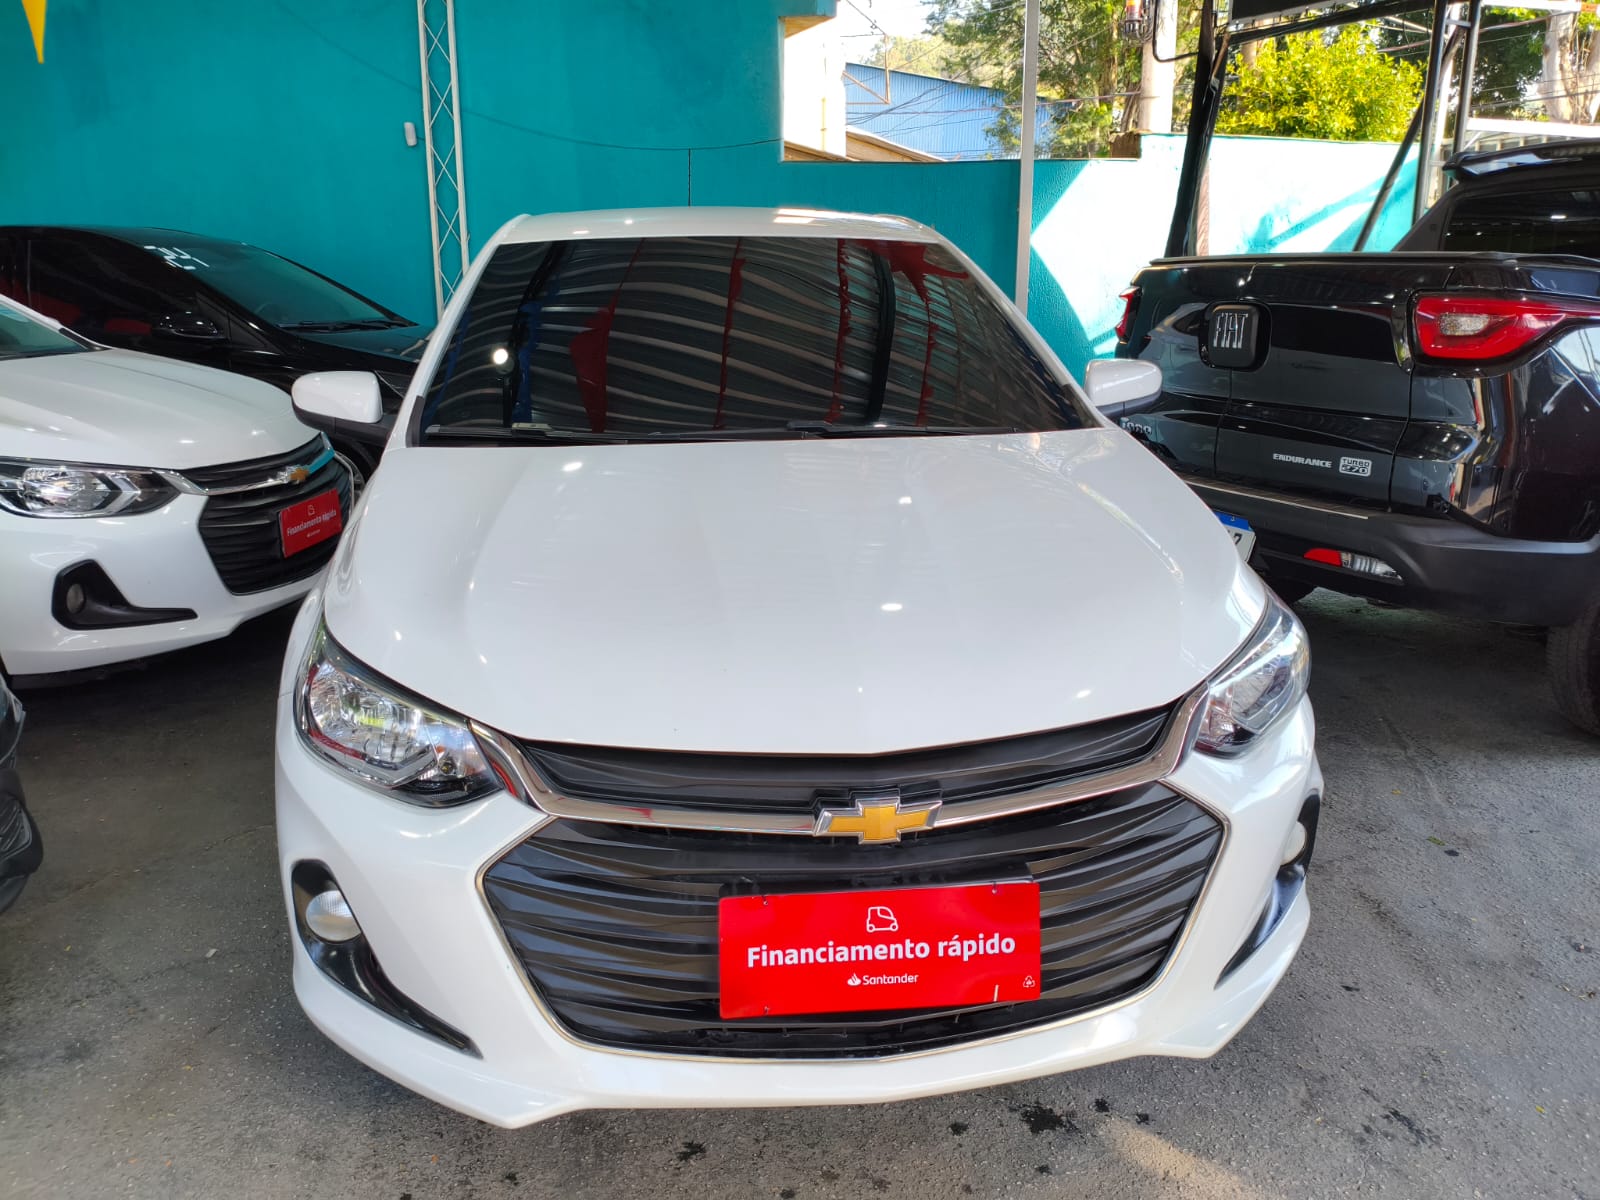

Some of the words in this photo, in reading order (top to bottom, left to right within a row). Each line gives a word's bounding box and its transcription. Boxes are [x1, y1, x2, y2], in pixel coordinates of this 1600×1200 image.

[1213, 312, 1249, 348] FIAT
[1272, 453, 1333, 468] ENDURANCE
[1341, 458, 1370, 467] TURBO
[747, 939, 930, 968] Financiamento
[938, 933, 1016, 962] rápido
[862, 973, 919, 986] Santander
